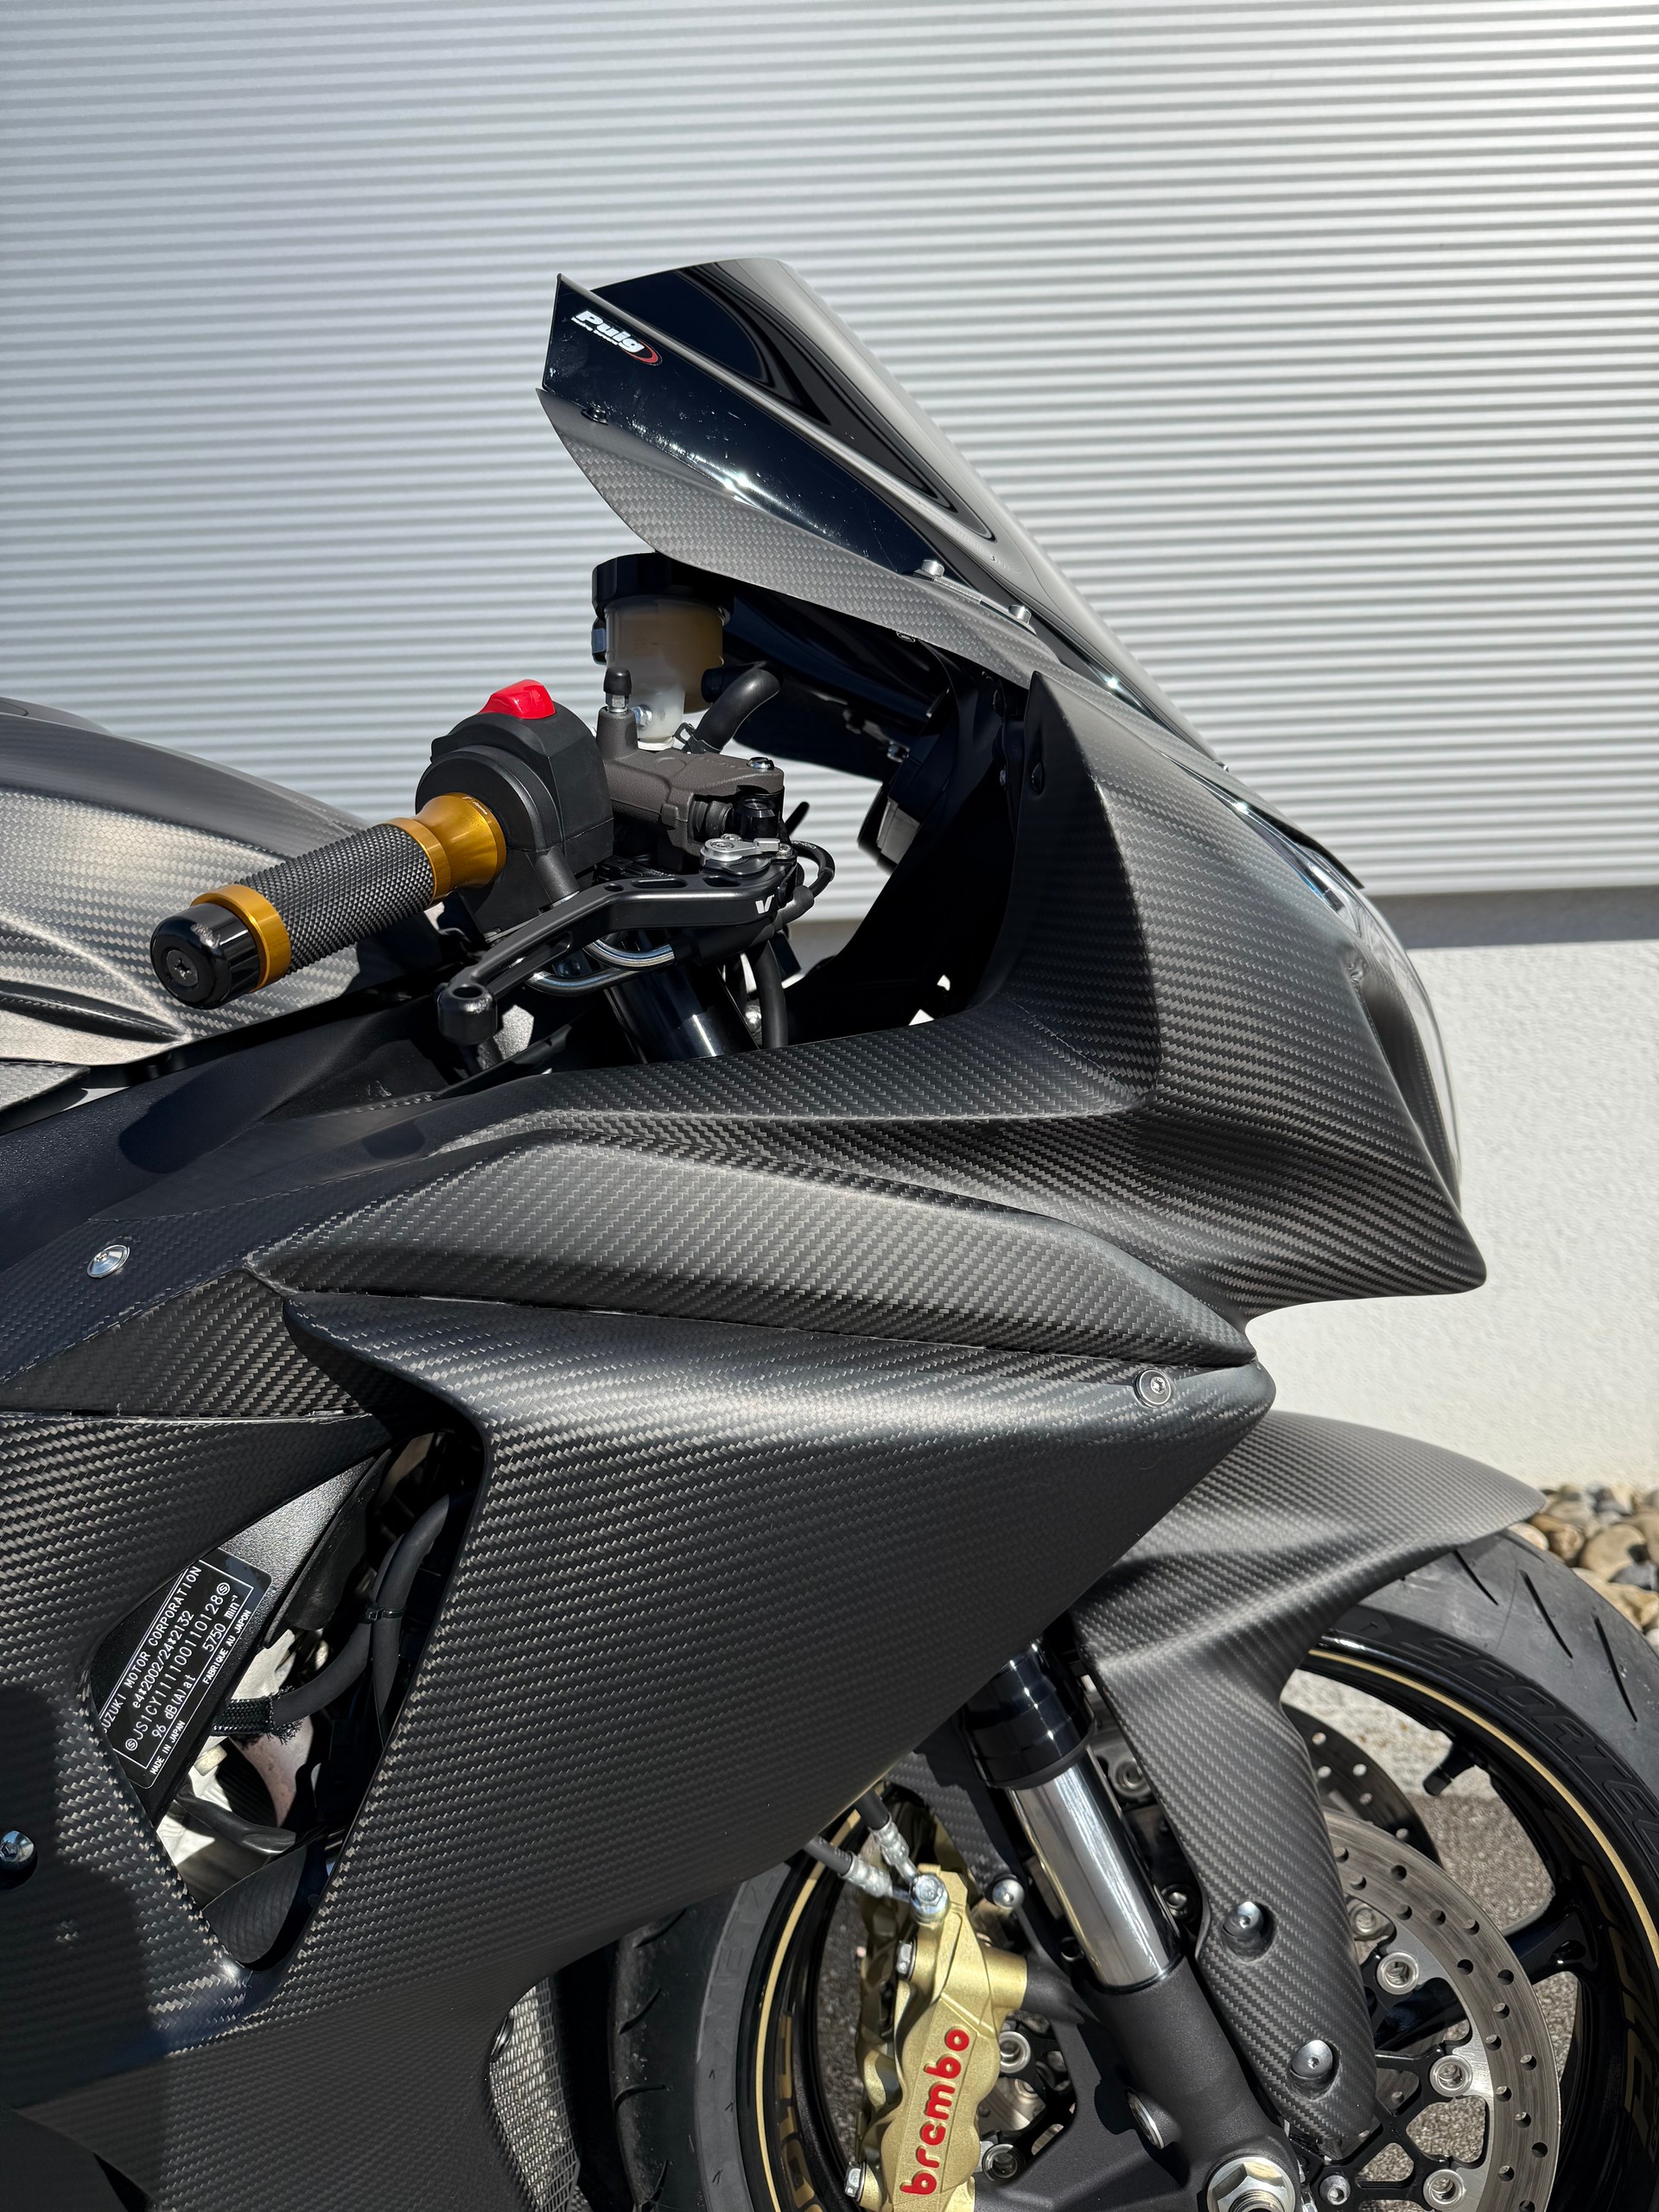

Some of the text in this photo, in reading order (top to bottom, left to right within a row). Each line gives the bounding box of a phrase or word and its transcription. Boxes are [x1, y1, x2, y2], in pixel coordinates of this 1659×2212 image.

[575, 310, 645, 353] Puig
[124, 1651, 151, 1688] MOTOR
[148, 1566, 202, 1646] CORPORATION
[202, 1609, 251, 1684] FABRIQUE AU JAPON
[151, 1724, 167, 1738] 96
[201, 1623, 226, 1652] 5750
[149, 1720, 186, 1775] MADE IN JAPAN
[901, 2029, 969, 2196] brembo
